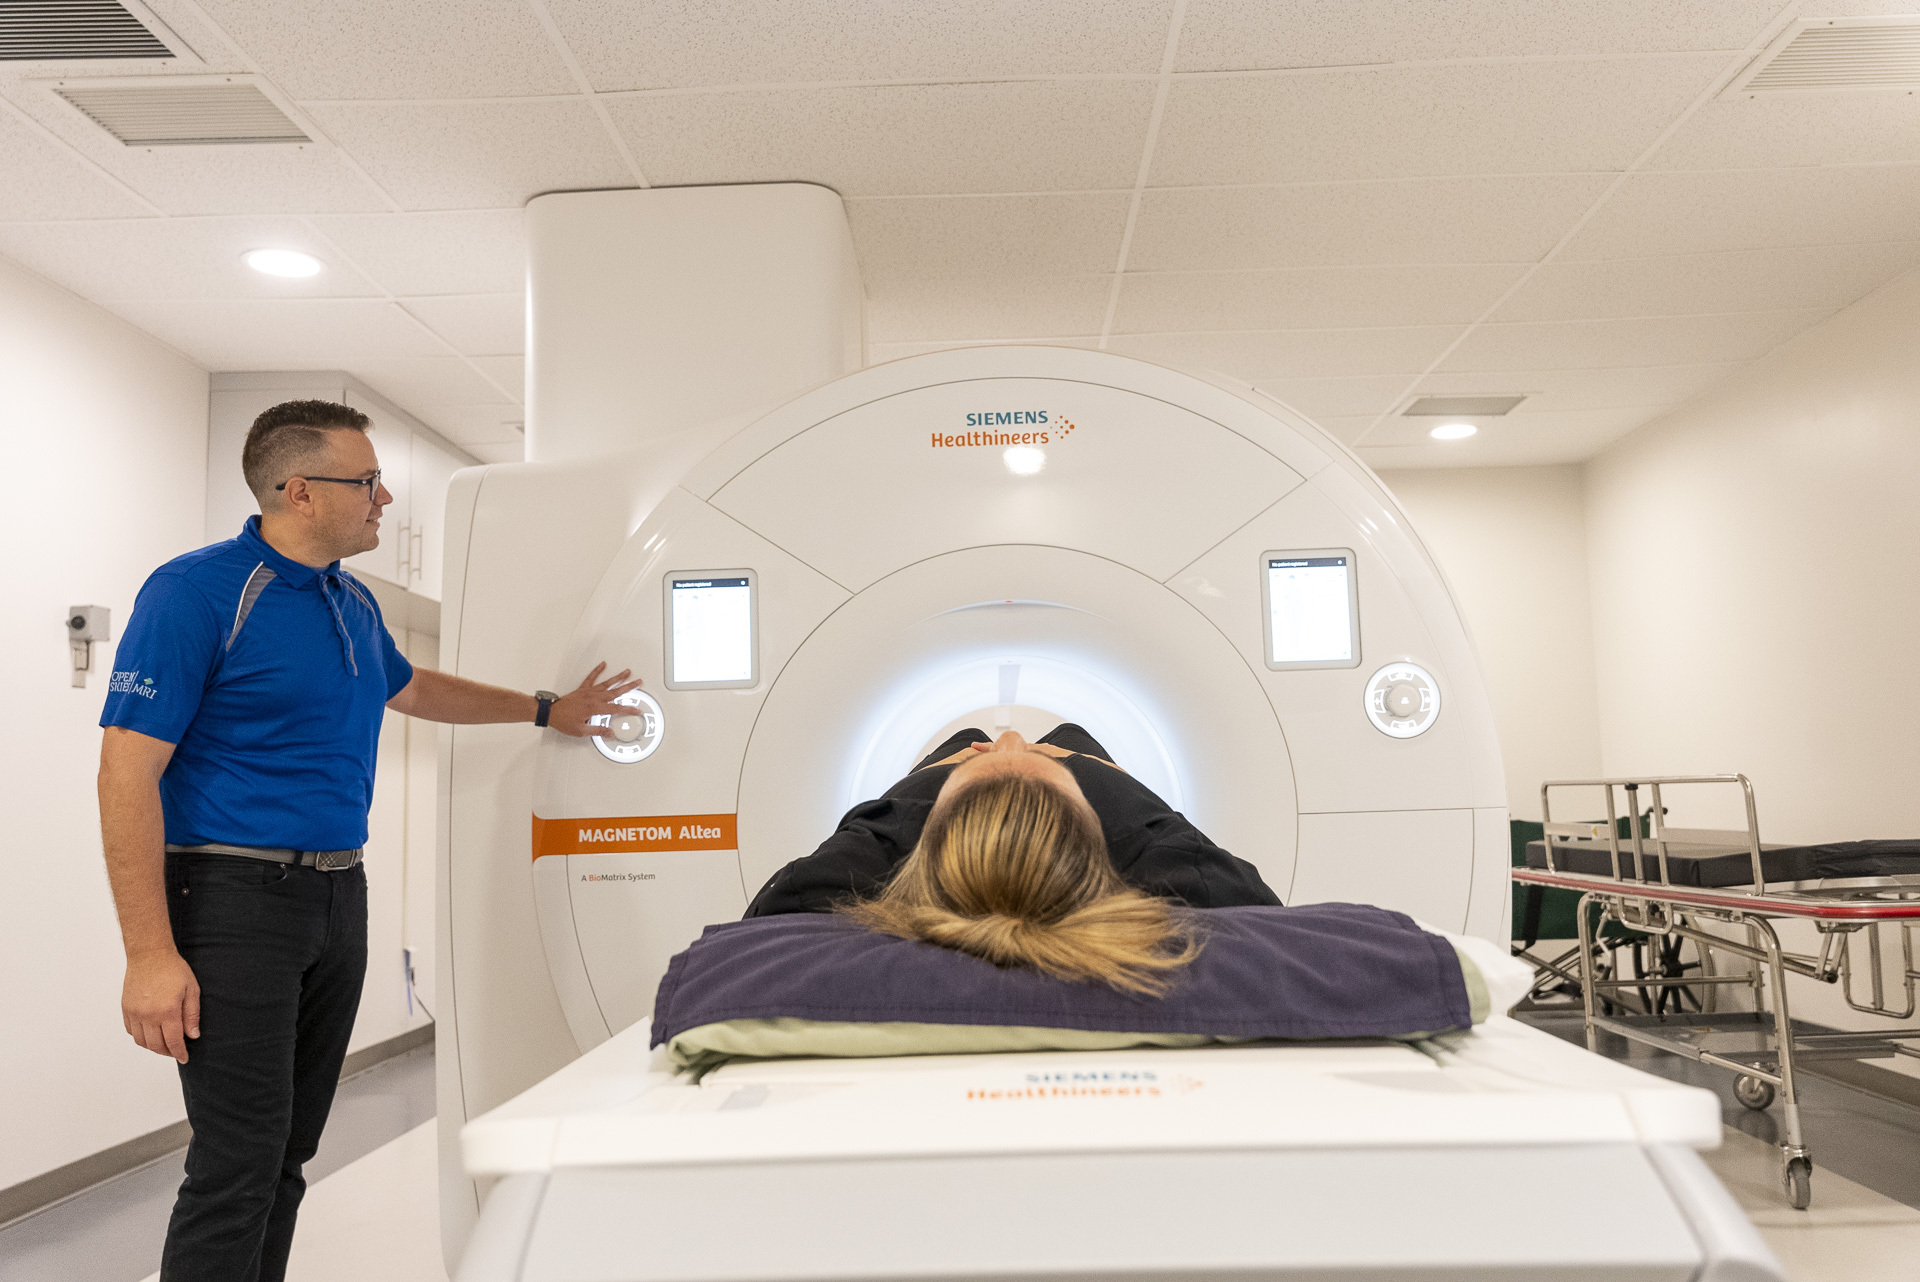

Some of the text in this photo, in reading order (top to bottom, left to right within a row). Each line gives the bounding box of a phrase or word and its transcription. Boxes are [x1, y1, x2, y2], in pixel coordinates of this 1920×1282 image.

[966, 410, 1049, 426] SIEMENS
[931, 429, 1049, 447] Healthineers
[111, 671, 136, 682] OPEN
[131, 683, 158, 700] MRI
[578, 824, 721, 843] MAGNETOM Altea
[588, 874, 627, 882] BioMatrix
[627, 873, 656, 882] System
[1025, 1071, 1158, 1083] SIEMENS
[965, 1085, 1162, 1100] Healthineers
